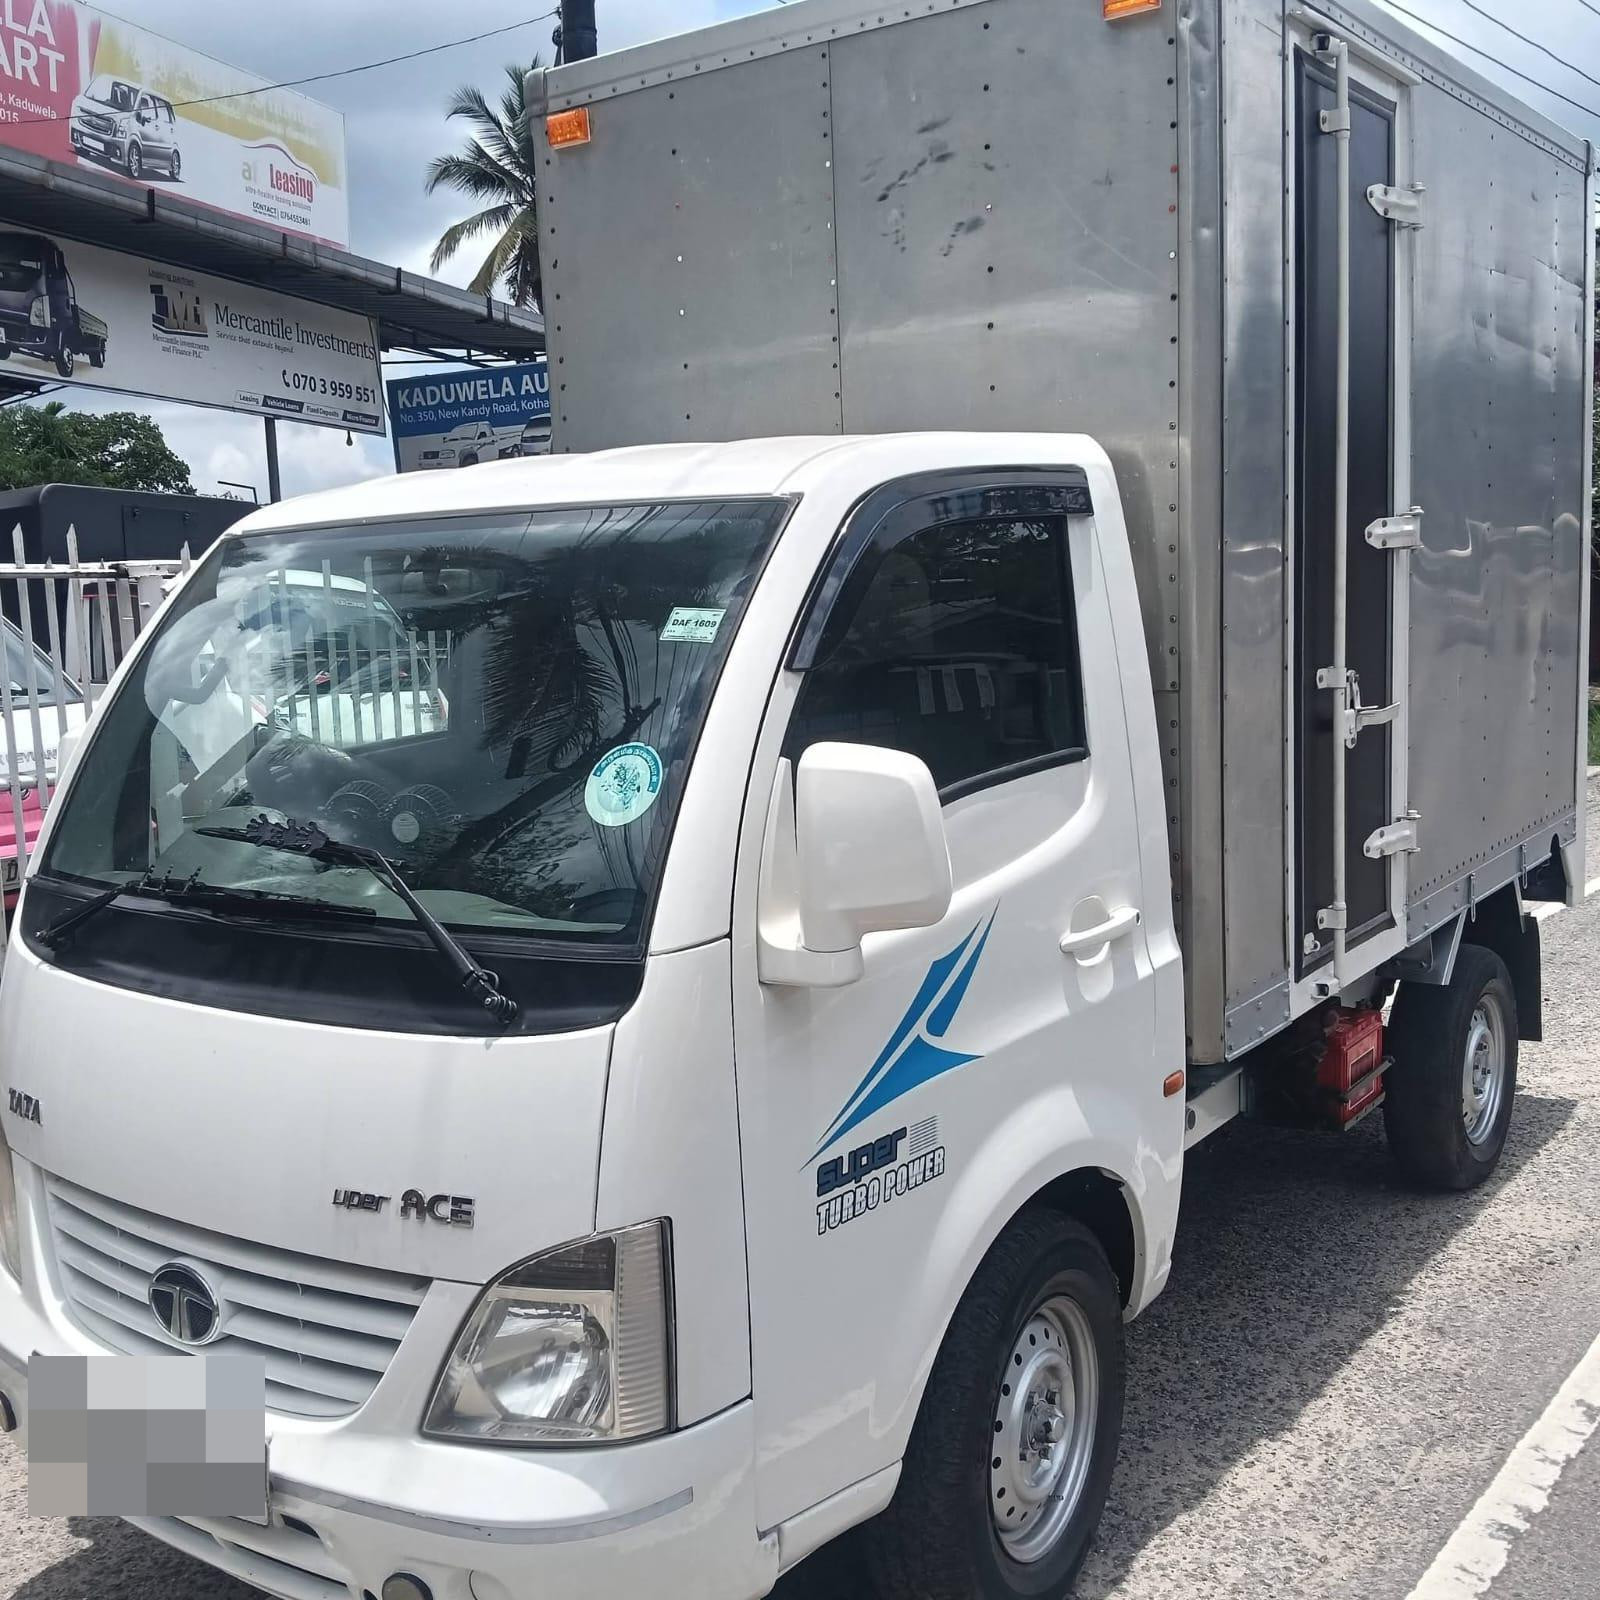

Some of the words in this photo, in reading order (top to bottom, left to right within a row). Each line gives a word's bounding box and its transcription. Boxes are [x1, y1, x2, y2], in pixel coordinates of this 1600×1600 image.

[8, 92, 57, 119] Kaduwela
[269, 163, 314, 204] Leasing
[213, 302, 293, 341] Mercantile
[295, 322, 375, 360] Investments
[292, 372, 317, 393] 070
[319, 378, 327, 395] 3
[330, 380, 353, 400] 959
[355, 385, 376, 404] 551
[397, 377, 515, 409] KADUWELA
[521, 372, 549, 395] AU
[400, 413, 415, 424] No.
[418, 409, 437, 422] 350,
[438, 408, 459, 420] New
[461, 405, 491, 418] Kandy
[493, 402, 520, 414] Road,
[521, 397, 549, 410] Kotha
[671, 618, 692, 627] DAF
[693, 619, 717, 628] 1609
[332, 1188, 392, 1214] uper
[400, 1188, 475, 1229] ACE
[816, 1176, 881, 1236] TURBO
[883, 1146, 946, 1203] POWER
